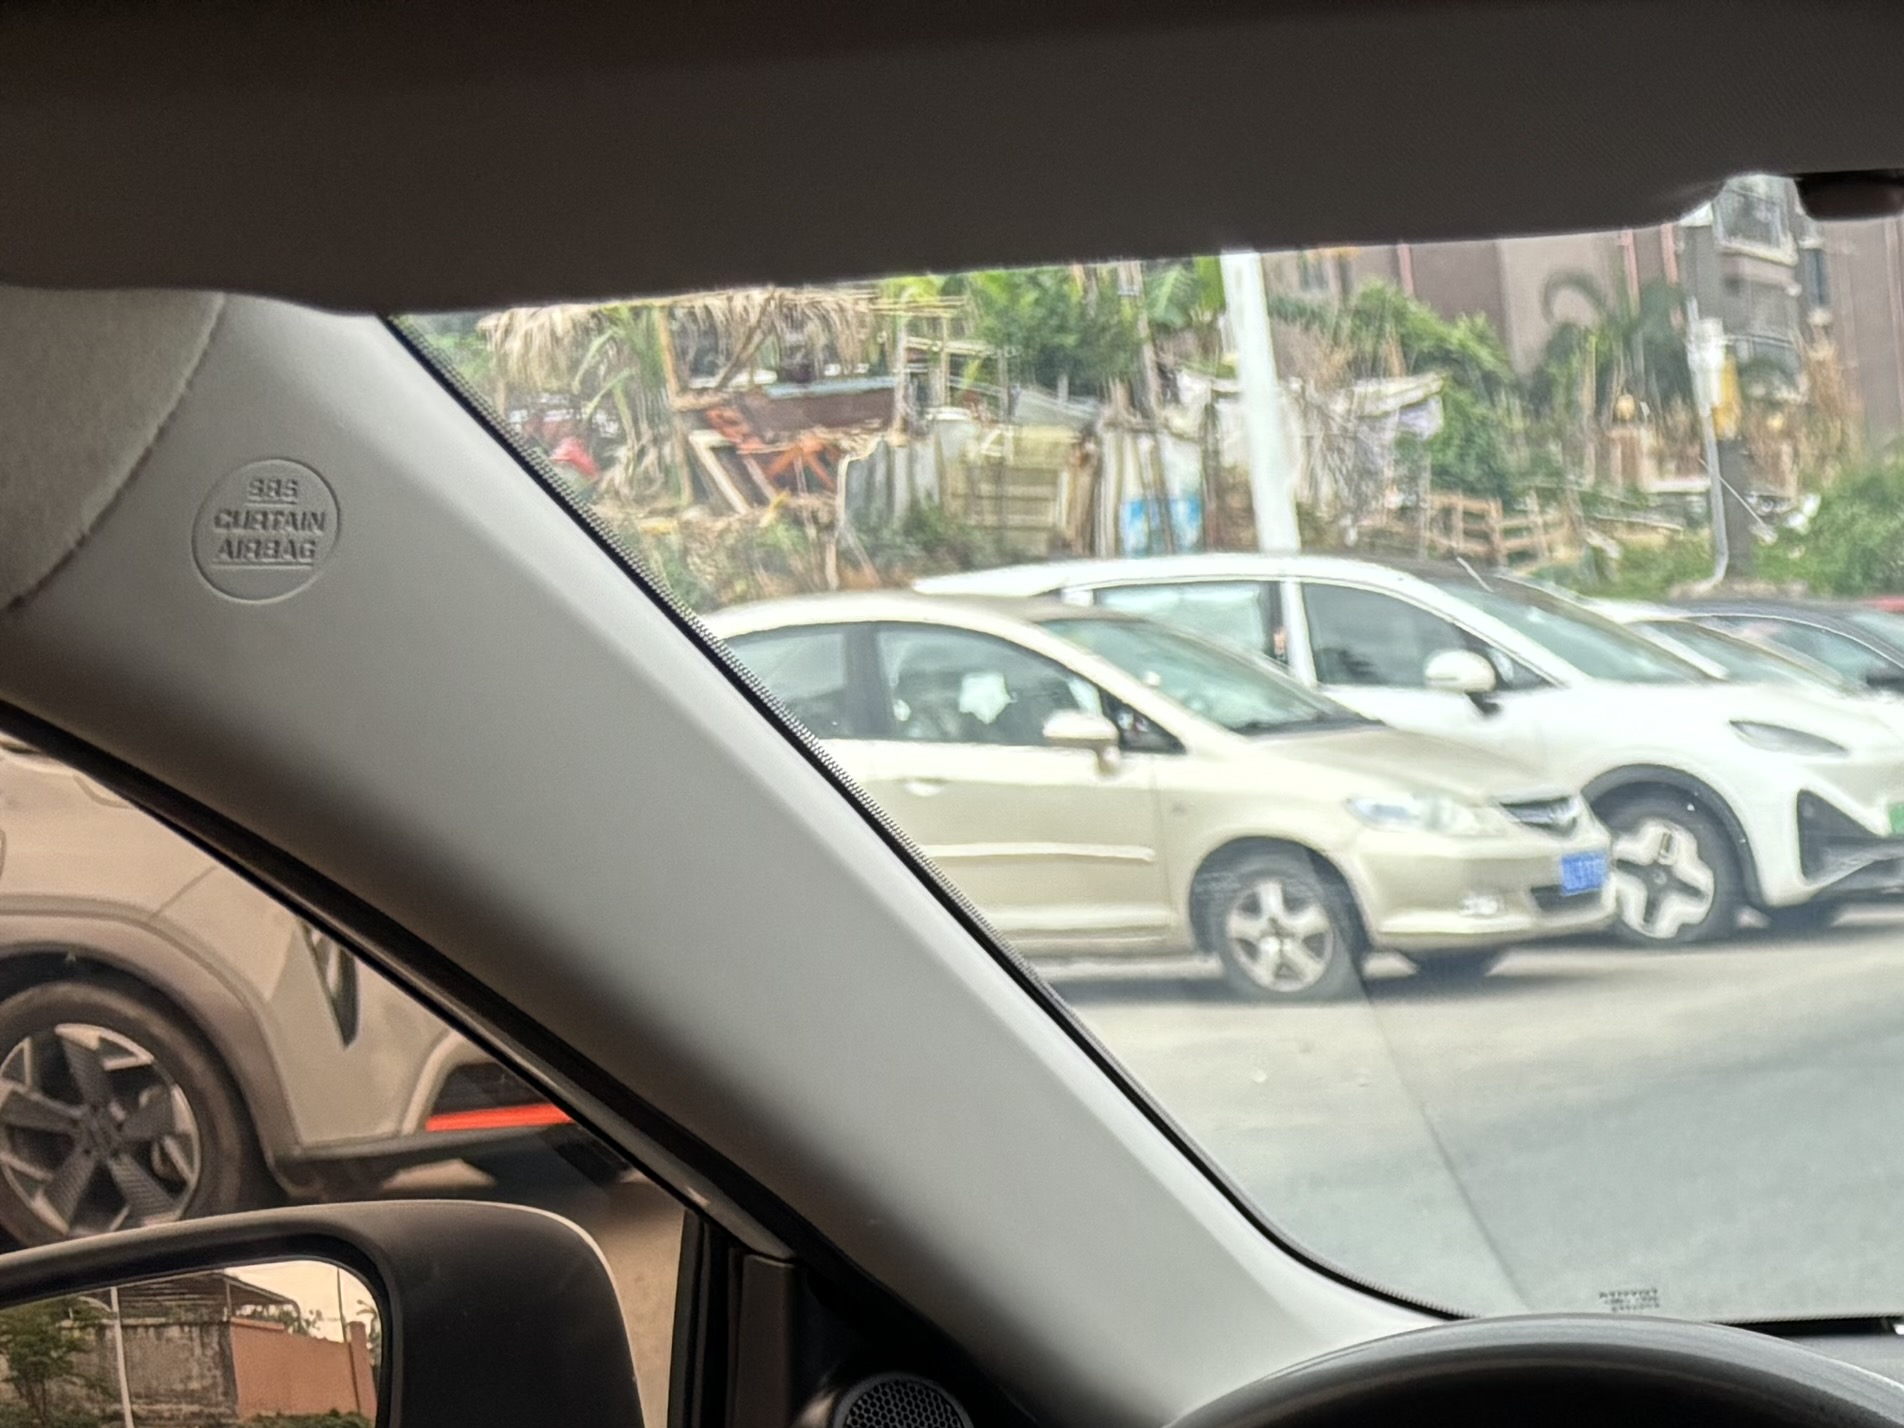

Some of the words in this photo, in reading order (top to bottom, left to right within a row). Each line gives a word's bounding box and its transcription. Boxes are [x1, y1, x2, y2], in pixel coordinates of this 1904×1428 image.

[247, 479, 299, 498] SRS
[214, 508, 325, 531] CURTAIN
[217, 538, 317, 561] AIRBAG
